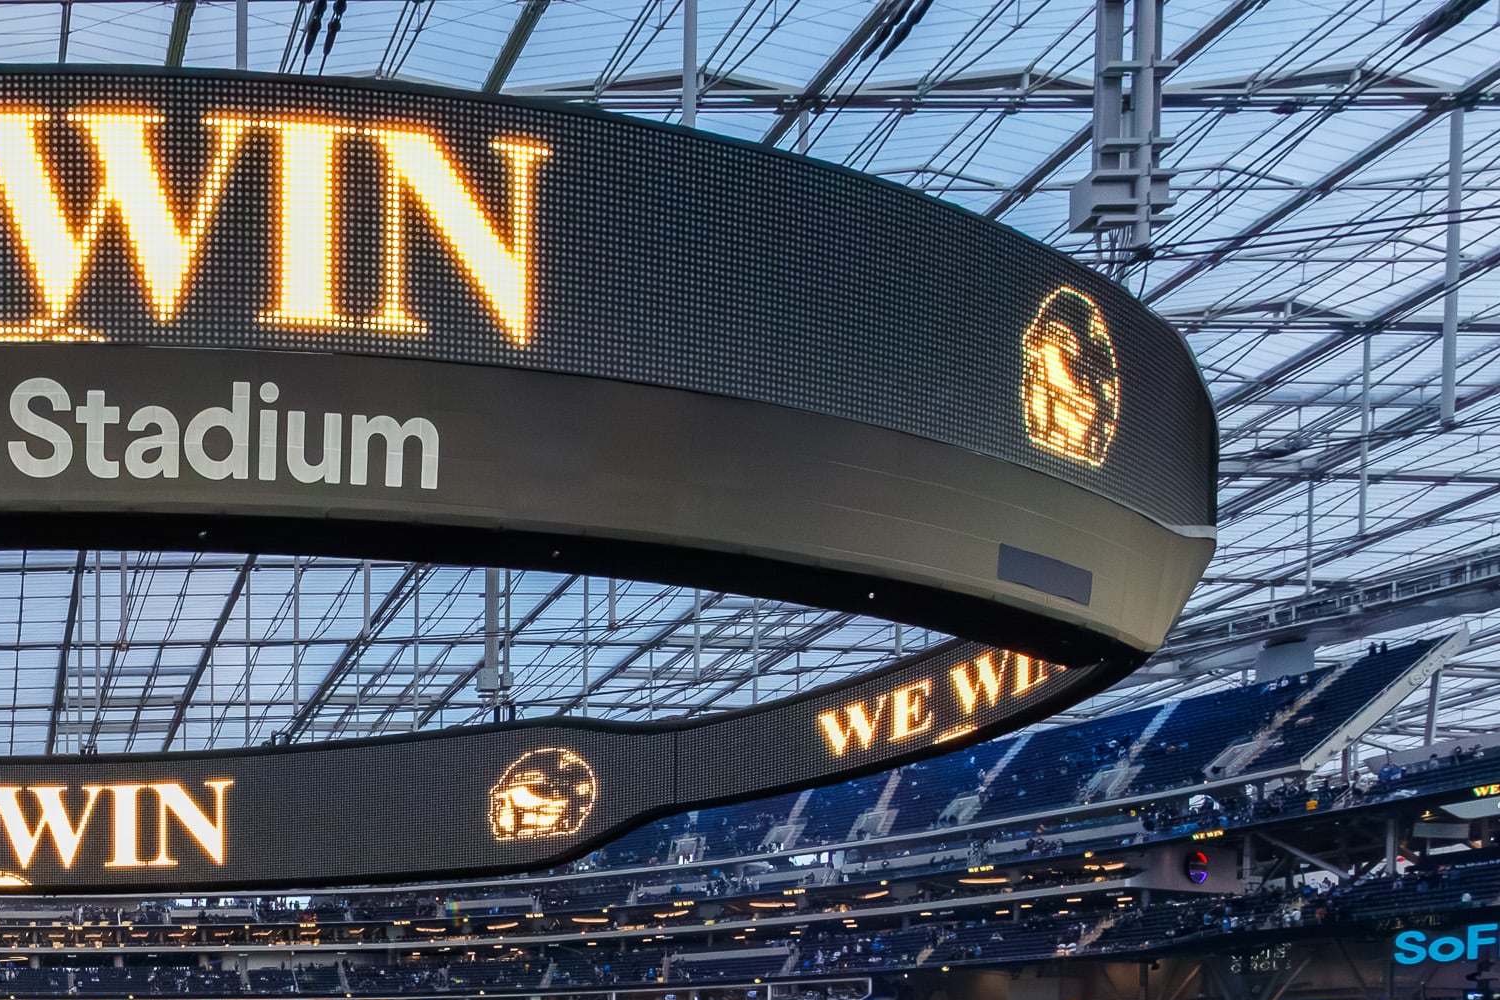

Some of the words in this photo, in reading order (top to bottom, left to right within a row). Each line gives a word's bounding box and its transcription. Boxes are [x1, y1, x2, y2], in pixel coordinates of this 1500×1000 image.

[7, 380, 441, 490] Stadium
[817, 677, 934, 758] WE
[1394, 923, 1500, 965] SoF
